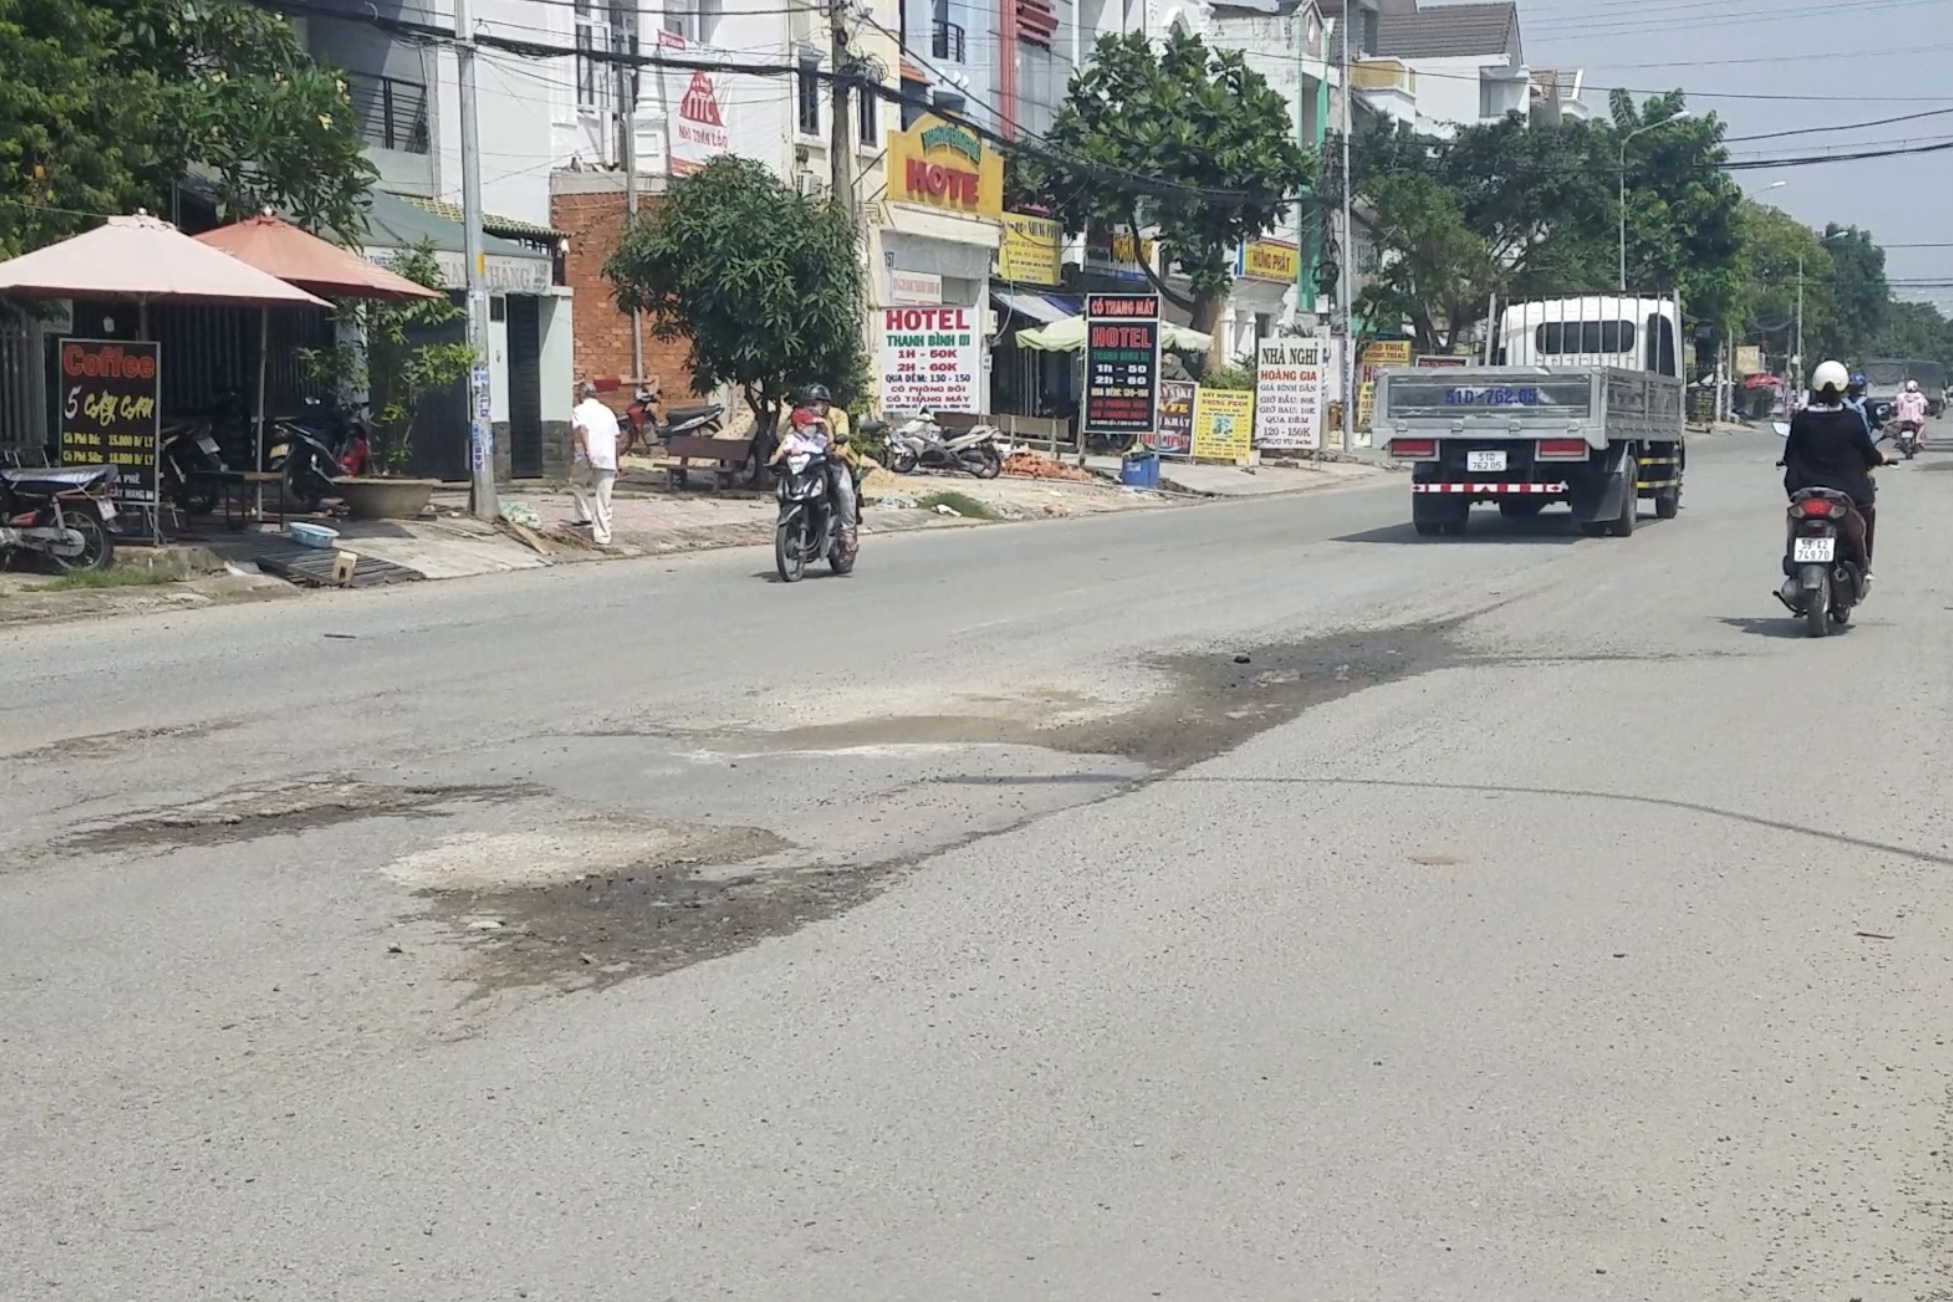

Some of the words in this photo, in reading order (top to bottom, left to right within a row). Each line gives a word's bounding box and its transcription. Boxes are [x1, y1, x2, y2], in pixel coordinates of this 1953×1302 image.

[1105, 300, 1134, 315] THANG
[885, 308, 971, 331] HOTEL
[887, 334, 925, 347] THANH
[928, 331, 956, 347] BÌNH
[1091, 326, 1152, 350] HOTEL
[898, 349, 916, 359] 1H
[930, 349, 958, 359] 50K
[1262, 343, 1285, 366] NHÀ
[1289, 341, 1318, 366] NGHỈ
[63, 344, 155, 379] Coffee
[897, 362, 916, 373] 2H
[1127, 364, 1148, 374] 50
[885, 373, 903, 384] QUA
[931, 373, 947, 383] 130
[955, 373, 971, 383] 150
[1260, 367, 1296, 381] HOÀNG
[1299, 370, 1317, 381] GIA
[64, 385, 83, 420] 5
[1264, 426, 1280, 437] 120
